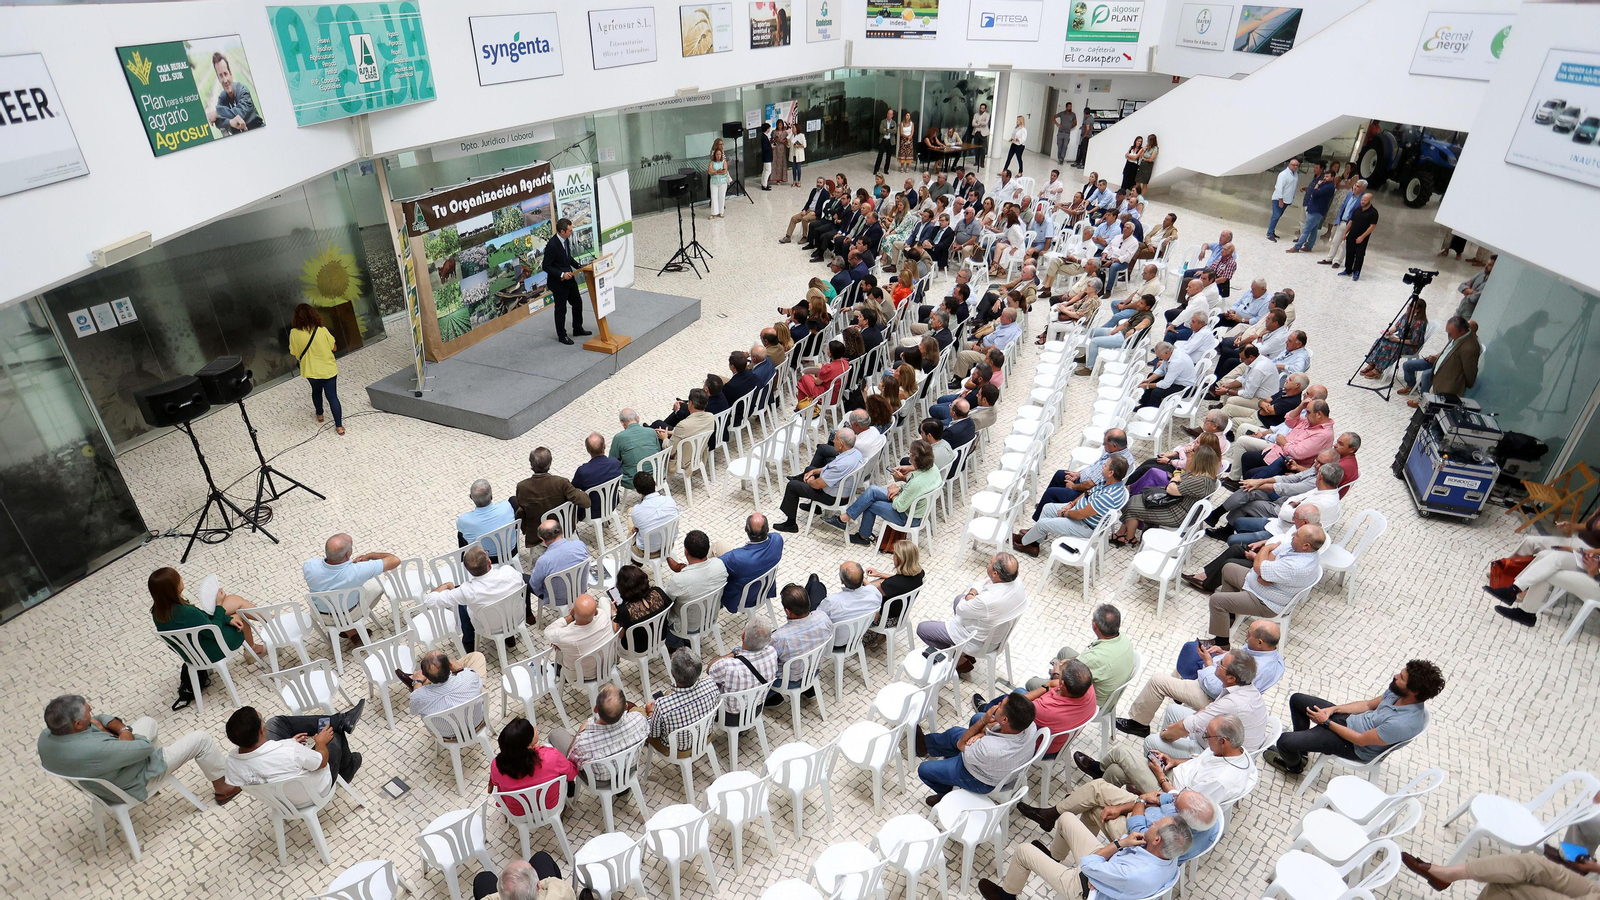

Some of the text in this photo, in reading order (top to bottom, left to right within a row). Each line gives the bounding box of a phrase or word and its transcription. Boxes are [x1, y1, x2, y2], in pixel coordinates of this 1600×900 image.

[1112, 5, 1140, 14] algosur
[996, 14, 1028, 23] FITESA
[1111, 14, 1138, 22] PLANT
[482, 37, 550, 65] syngenta
[1088, 46, 1115, 54] Cafetería
[156, 61, 189, 73] CAJA RURAL
[1065, 54, 1121, 66] El Campero
[159, 72, 184, 83] DEL SUR
[0, 87, 55, 127] EER
[140, 94, 168, 111] Plan
[167, 98, 179, 108] para
[184, 93, 200, 102] sector
[148, 106, 189, 132] agrario
[155, 124, 210, 150] Agrosur
[461, 141, 480, 152] Dpto.
[481, 135, 506, 148] Jurídico
[511, 131, 534, 142] Laboral
[558, 184, 592, 198] MIGASA
[432, 205, 448, 219] Tu
[449, 184, 518, 214] Organización
